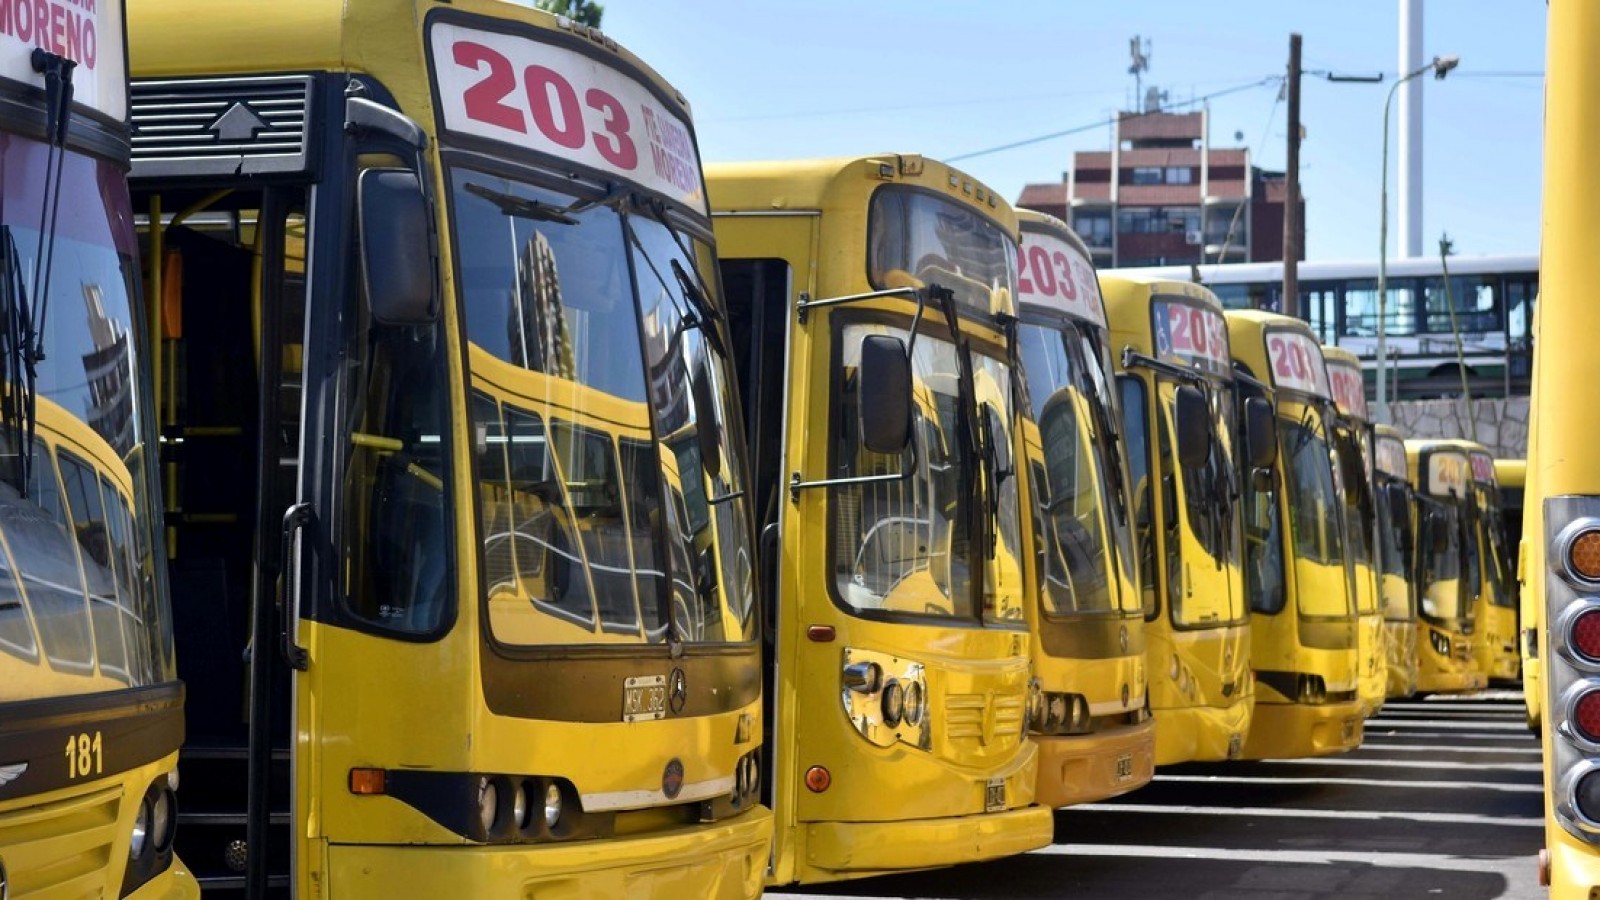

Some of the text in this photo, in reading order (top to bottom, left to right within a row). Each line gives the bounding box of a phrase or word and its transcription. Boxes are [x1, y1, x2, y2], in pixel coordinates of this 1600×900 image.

[452, 41, 638, 170] 203
[1017, 244, 1077, 301] 203
[65, 731, 103, 779] 181
